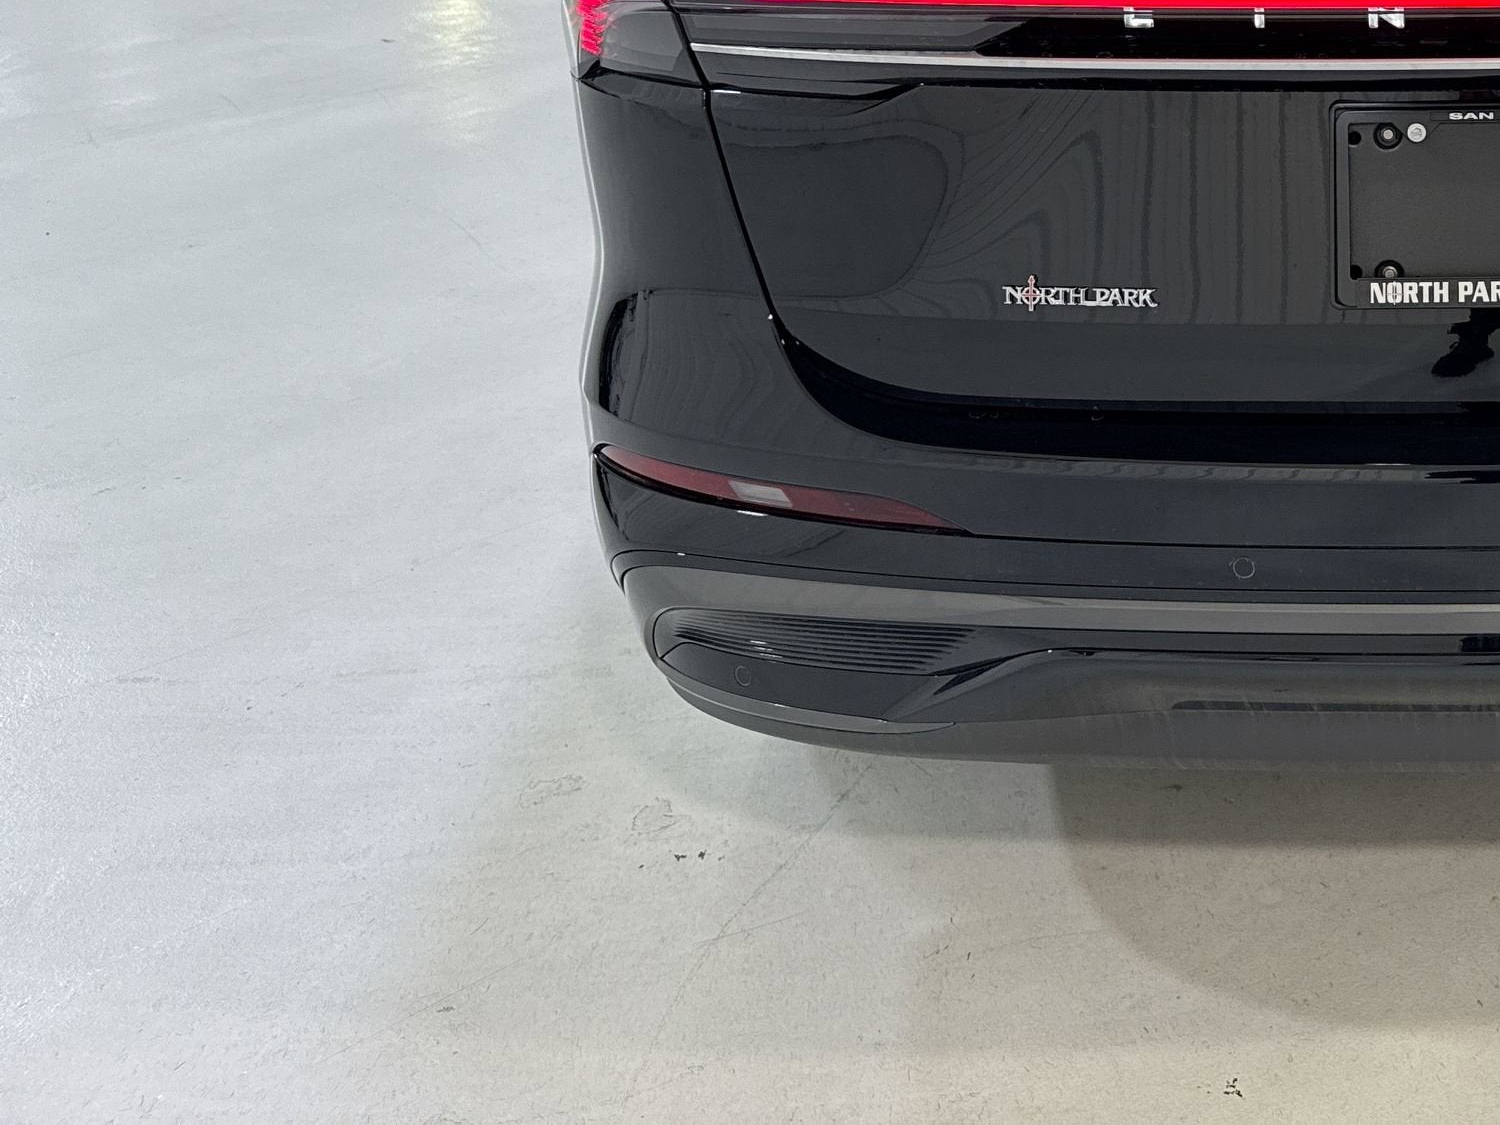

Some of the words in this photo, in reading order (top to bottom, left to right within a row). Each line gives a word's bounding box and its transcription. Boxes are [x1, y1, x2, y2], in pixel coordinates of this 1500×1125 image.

[1449, 111, 1494, 120] SAN
[1002, 276, 1088, 311] NORTH
[1093, 287, 1158, 308] PARK
[1370, 281, 1449, 305] NORTH
